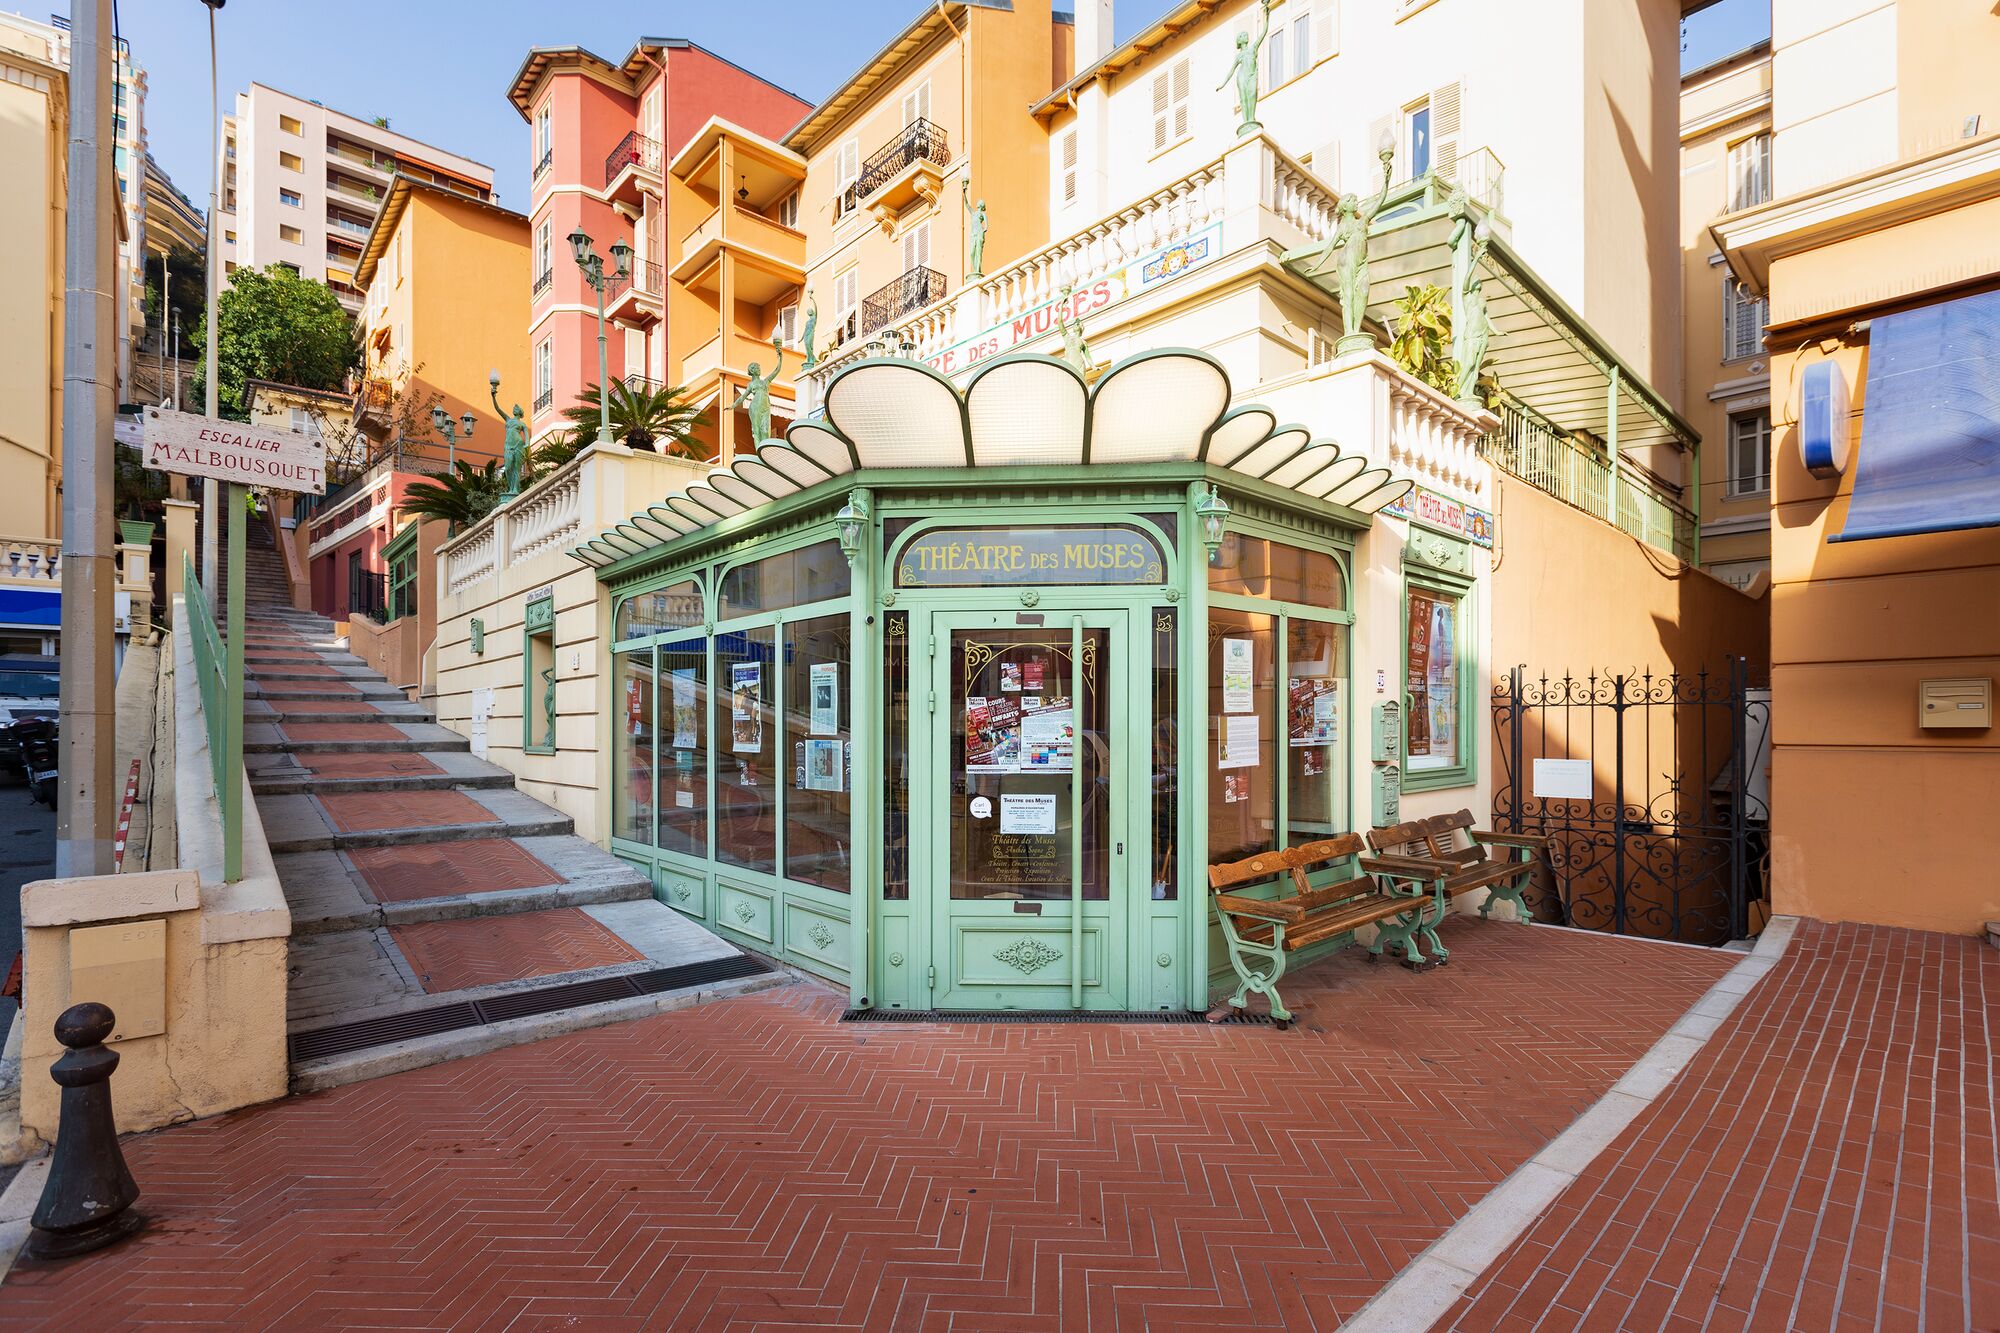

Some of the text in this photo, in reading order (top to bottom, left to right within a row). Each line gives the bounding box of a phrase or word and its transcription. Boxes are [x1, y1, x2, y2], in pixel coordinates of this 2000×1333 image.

[968, 338, 999, 363] DES
[1011, 280, 1111, 345] MUSES
[199, 429, 281, 452] ESCALIER
[152, 442, 321, 482] MALBOUSQUET
[915, 542, 1145, 573] THÉÂTRE DES MUSES
